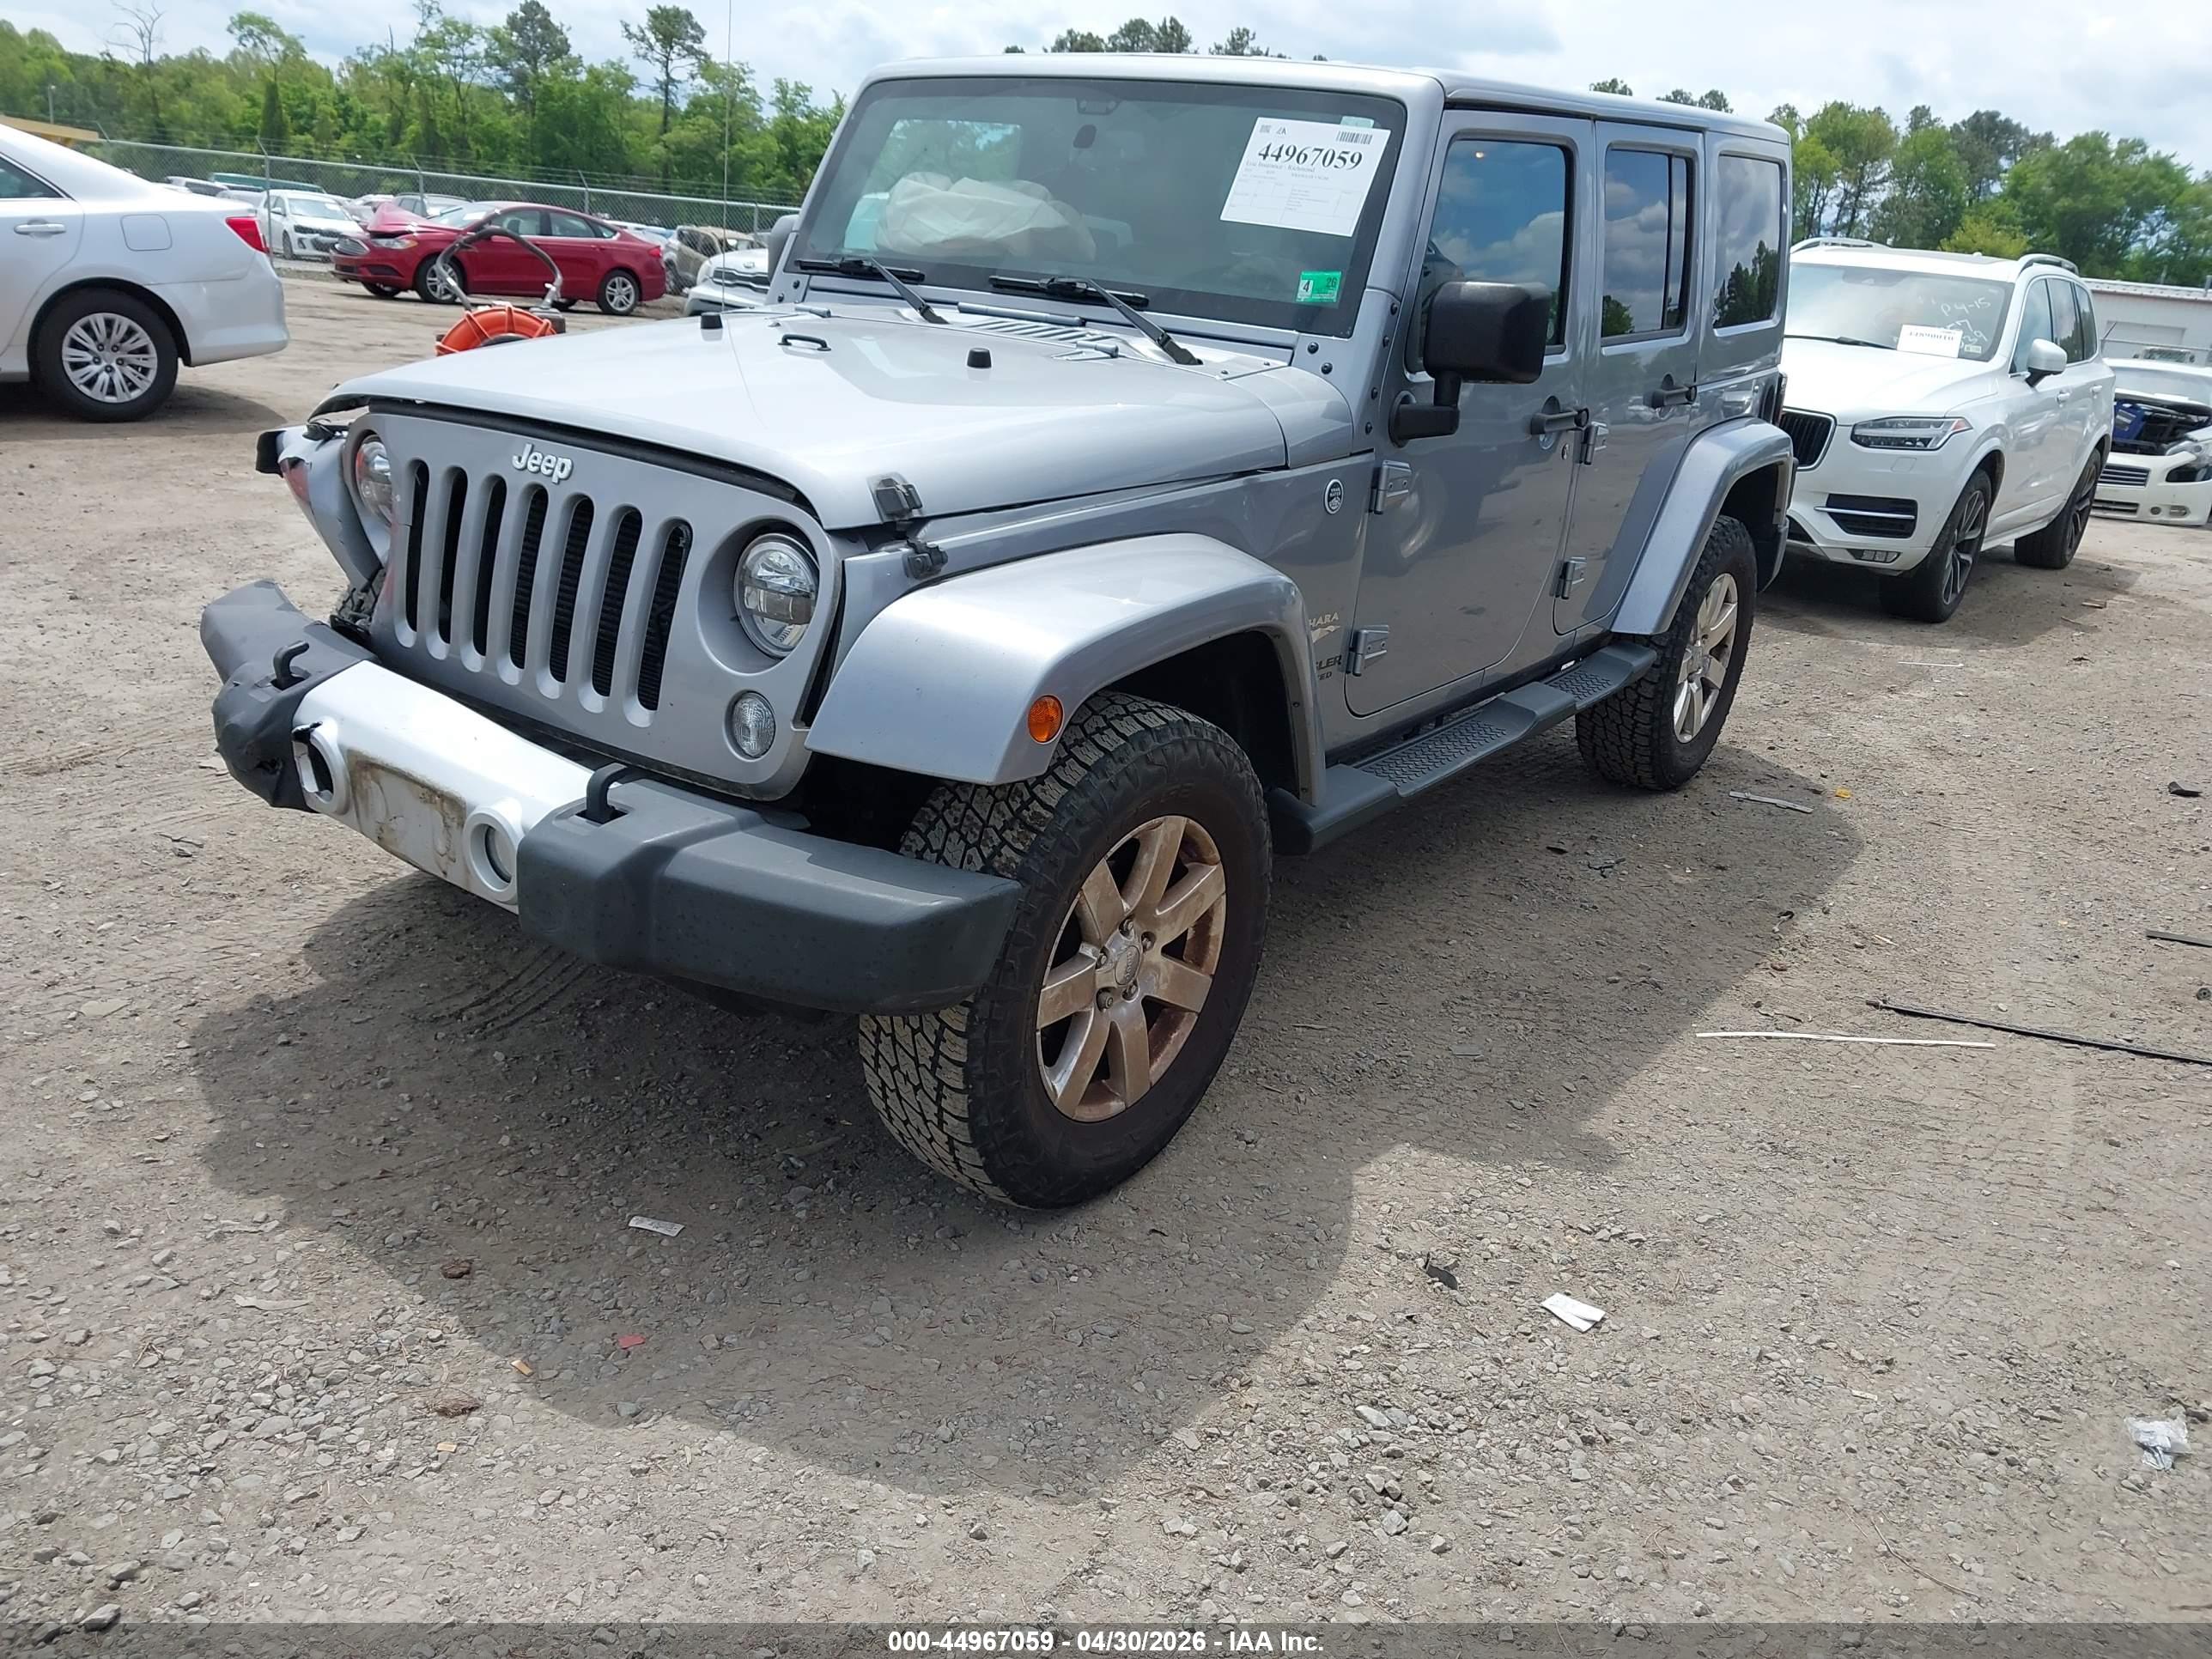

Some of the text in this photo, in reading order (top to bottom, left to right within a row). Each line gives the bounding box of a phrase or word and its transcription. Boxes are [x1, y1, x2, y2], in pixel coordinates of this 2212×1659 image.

[1258, 143, 1363, 171] 44967059
[1303, 280, 1310, 293] 4
[512, 443, 574, 484] Jeep
